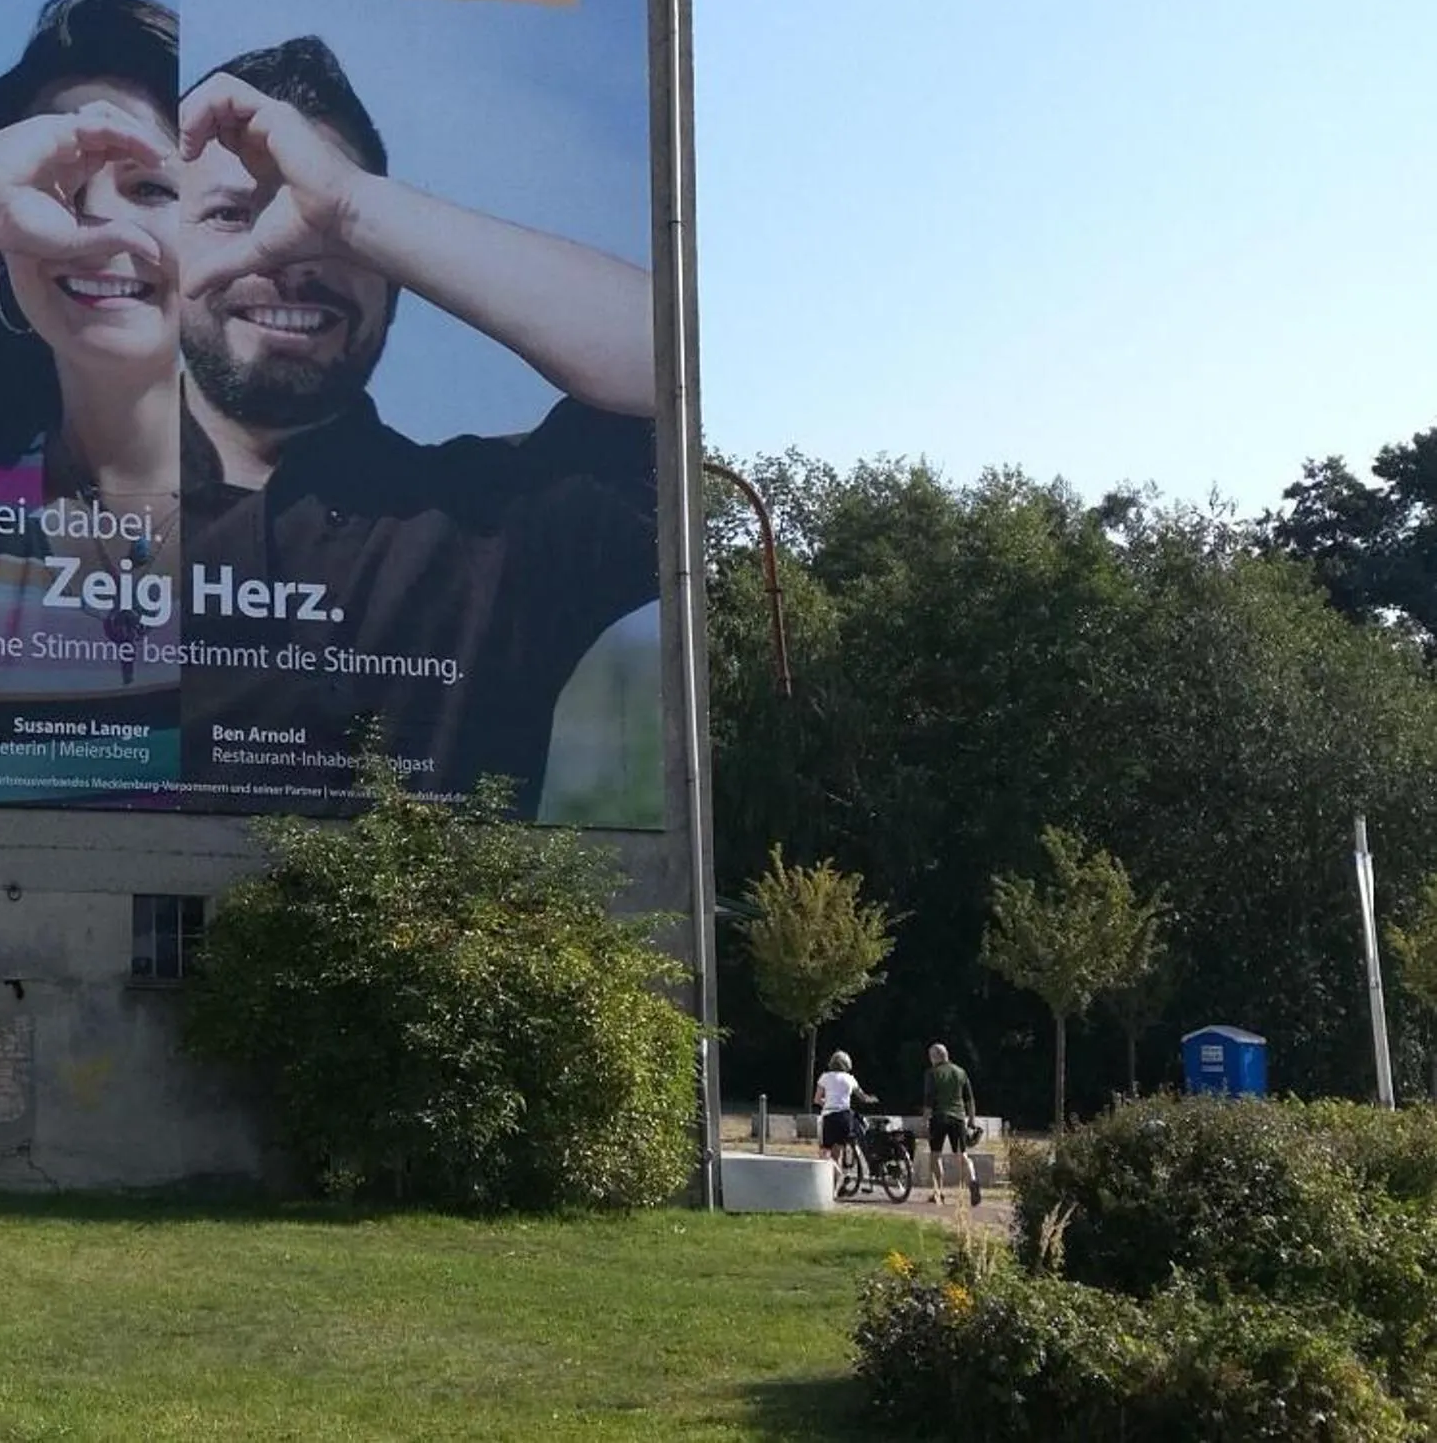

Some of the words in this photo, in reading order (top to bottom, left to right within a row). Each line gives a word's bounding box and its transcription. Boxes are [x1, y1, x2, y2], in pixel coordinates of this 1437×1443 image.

[40, 497, 163, 542] dabei.
[43, 556, 172, 627] Zeig
[192, 562, 345, 623] Herz.
[30, 631, 136, 663] Stimme
[142, 636, 269, 670] bestimmt
[276, 643, 316, 671] die
[323, 645, 464, 686] Stimmung.
[13, 716, 87, 736] Susanne
[90, 719, 151, 740] Langer
[212, 724, 245, 742] Ben
[248, 726, 306, 744] Arnold
[59, 740, 150, 764] Meiersberg
[383, 753, 435, 774] olgast
[285, 784, 323, 798] Partner
